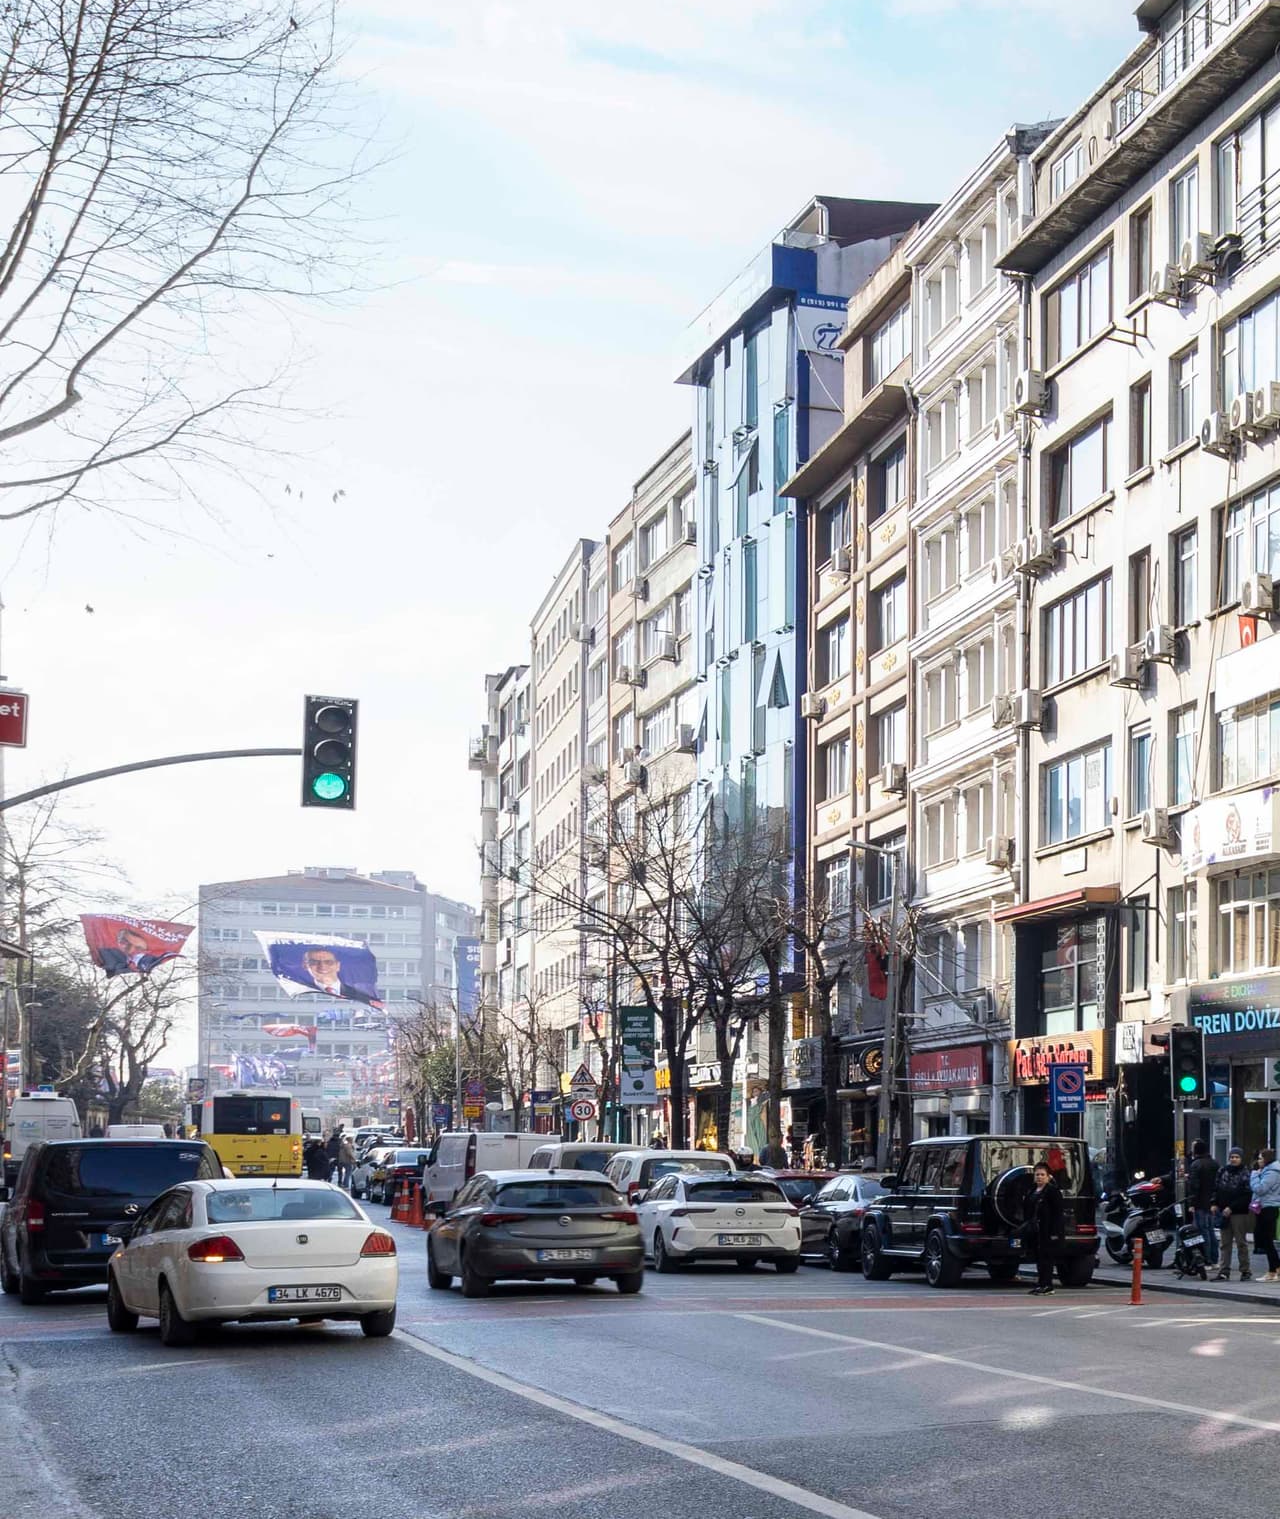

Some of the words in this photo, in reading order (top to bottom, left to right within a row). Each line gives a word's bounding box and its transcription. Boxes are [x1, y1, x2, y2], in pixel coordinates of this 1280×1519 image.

[576, 1105, 590, 1116] 30
[276, 1288, 289, 1299] 34
[296, 1287, 309, 1299] LK
[315, 1287, 339, 1298] 4676
